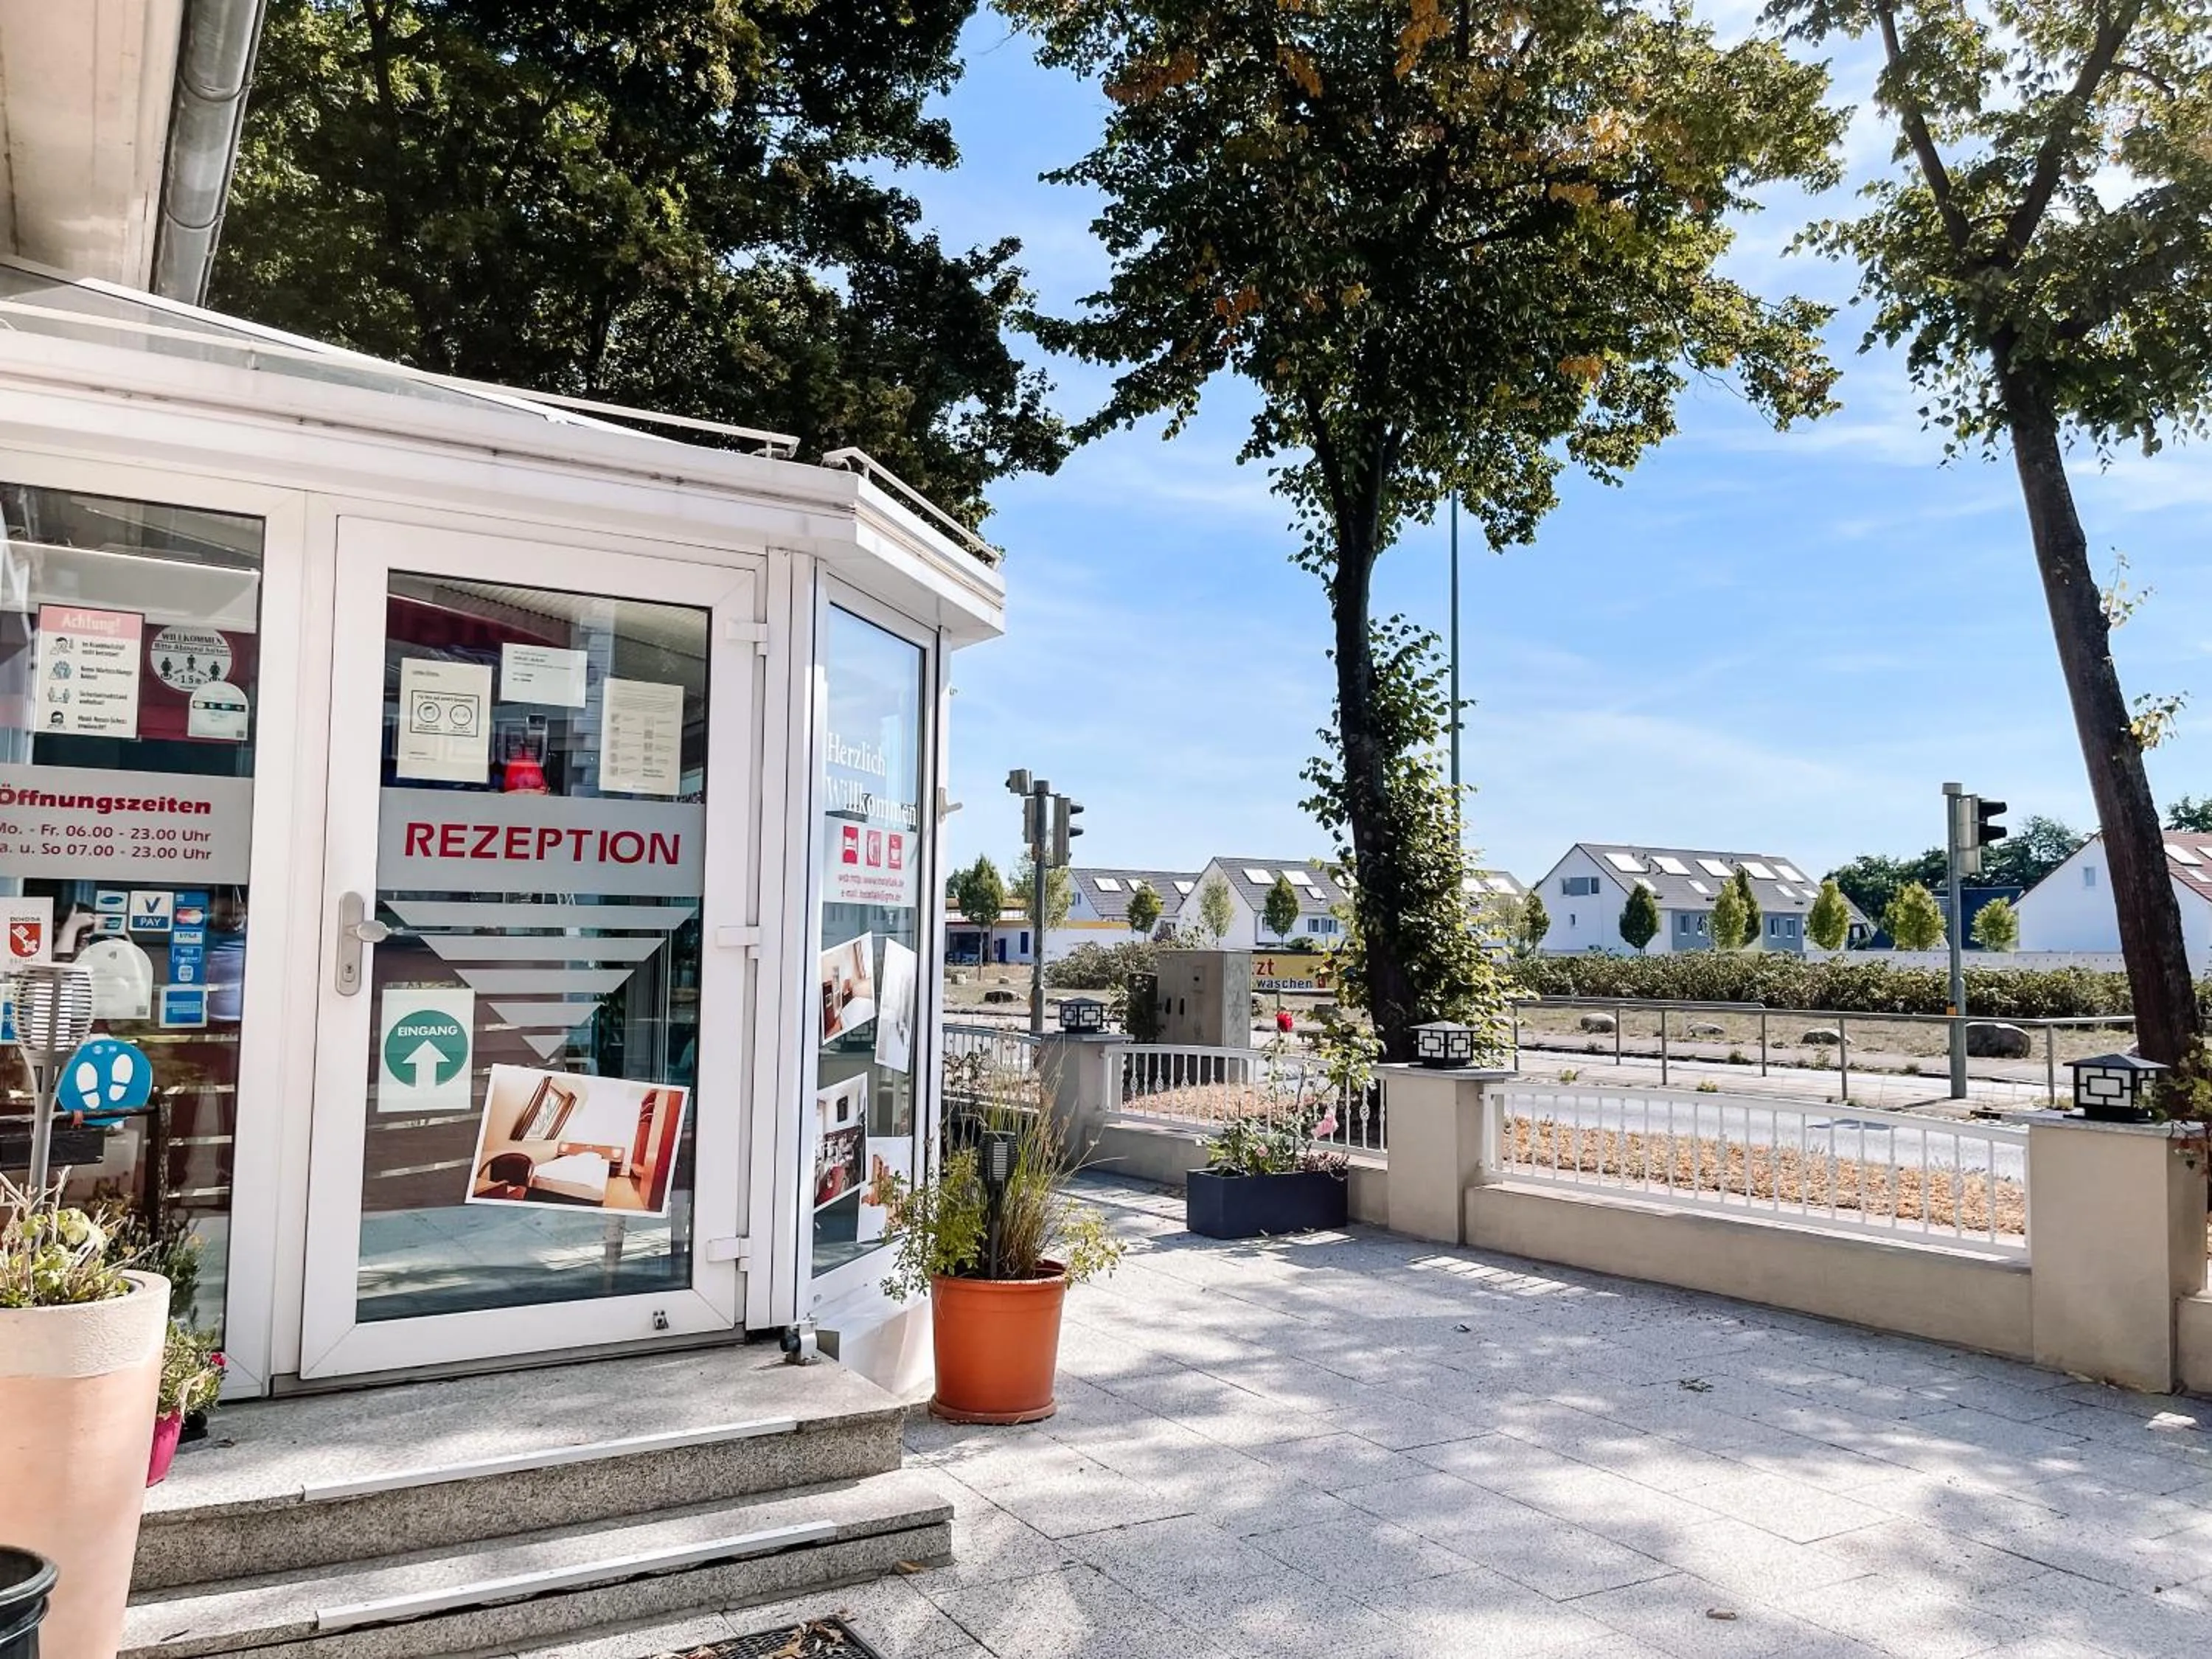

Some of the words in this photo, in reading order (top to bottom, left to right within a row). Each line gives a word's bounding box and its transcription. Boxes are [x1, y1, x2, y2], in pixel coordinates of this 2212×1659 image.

[62, 613, 121, 635] Achtung!
[826, 732, 886, 776] Herzlich
[0, 783, 211, 814] Öffnungszeiten
[826, 776, 917, 826] Willkommen
[41, 824, 59, 836] Fr.
[66, 825, 113, 838] 06.00
[131, 828, 176, 841] 23.00
[182, 830, 211, 842] Uhr
[20, 844, 35, 854] u.
[41, 843, 61, 855] So
[66, 844, 114, 856] 07.00
[131, 846, 178, 859] 23.00
[183, 848, 212, 860] Uhr
[404, 822, 681, 865] REZEPTION
[145, 897, 161, 914] V
[139, 917, 161, 927] PAY
[1252, 957, 1275, 975] zt
[1256, 978, 1313, 989] waschen
[397, 1025, 458, 1037] EINGANG
